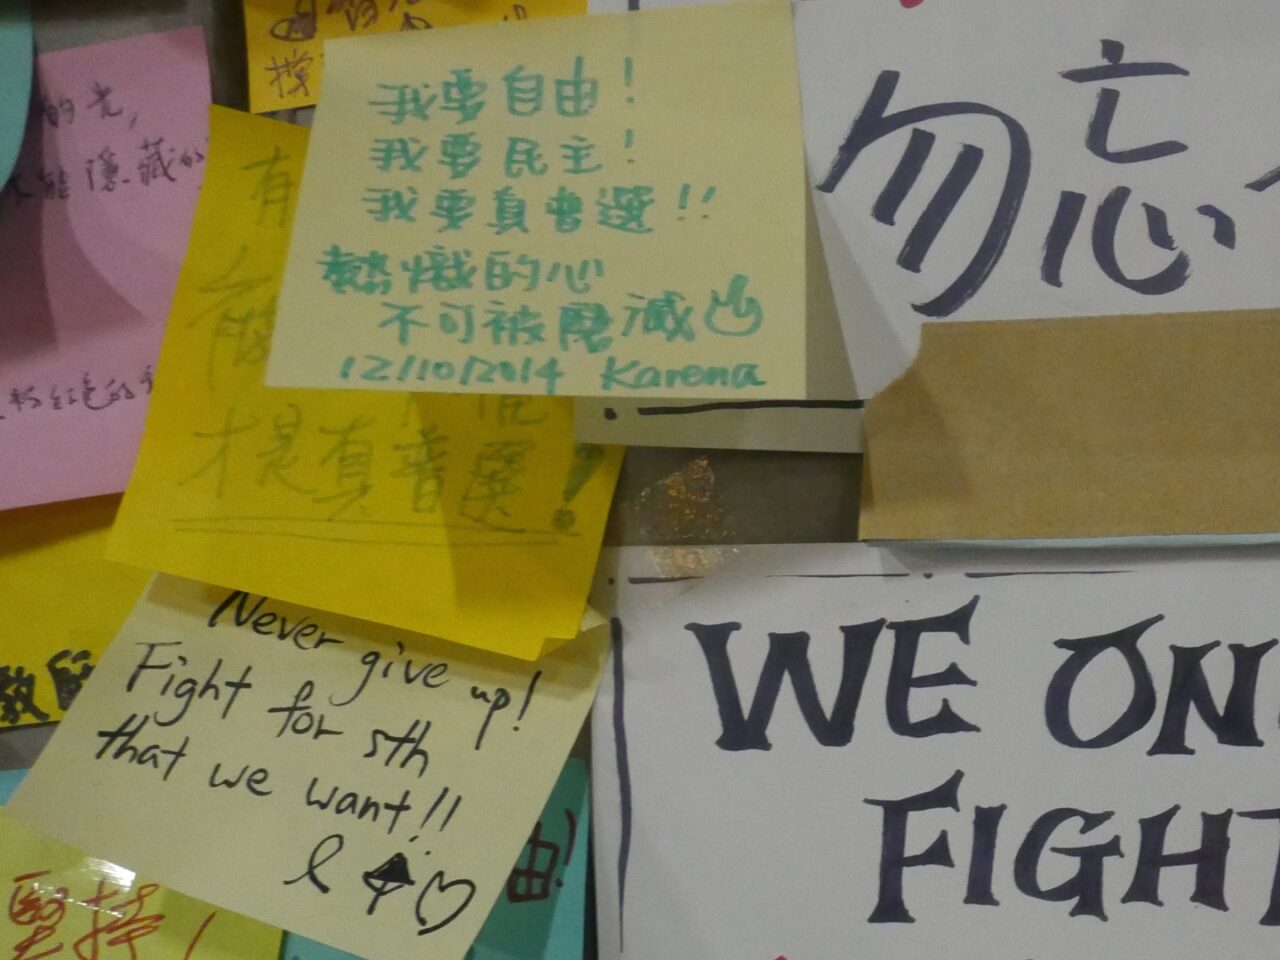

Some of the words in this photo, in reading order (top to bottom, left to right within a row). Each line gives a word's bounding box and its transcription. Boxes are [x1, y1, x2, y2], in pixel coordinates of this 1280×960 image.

[369, 56, 635, 124] 我要自由!
[369, 128, 636, 180] 我要民主!
[340, 355, 567, 395] 12/10/2014
[125, 640, 253, 727] Fight
[267, 680, 344, 738] for
[364, 720, 431, 776] sth
[207, 590, 346, 650] Never
[330, 641, 450, 707] give
[471, 671, 543, 751] up!
[684, 595, 982, 751] WE
[96, 713, 191, 781] that
[208, 761, 274, 797] we
[306, 776, 462, 858] want!!
